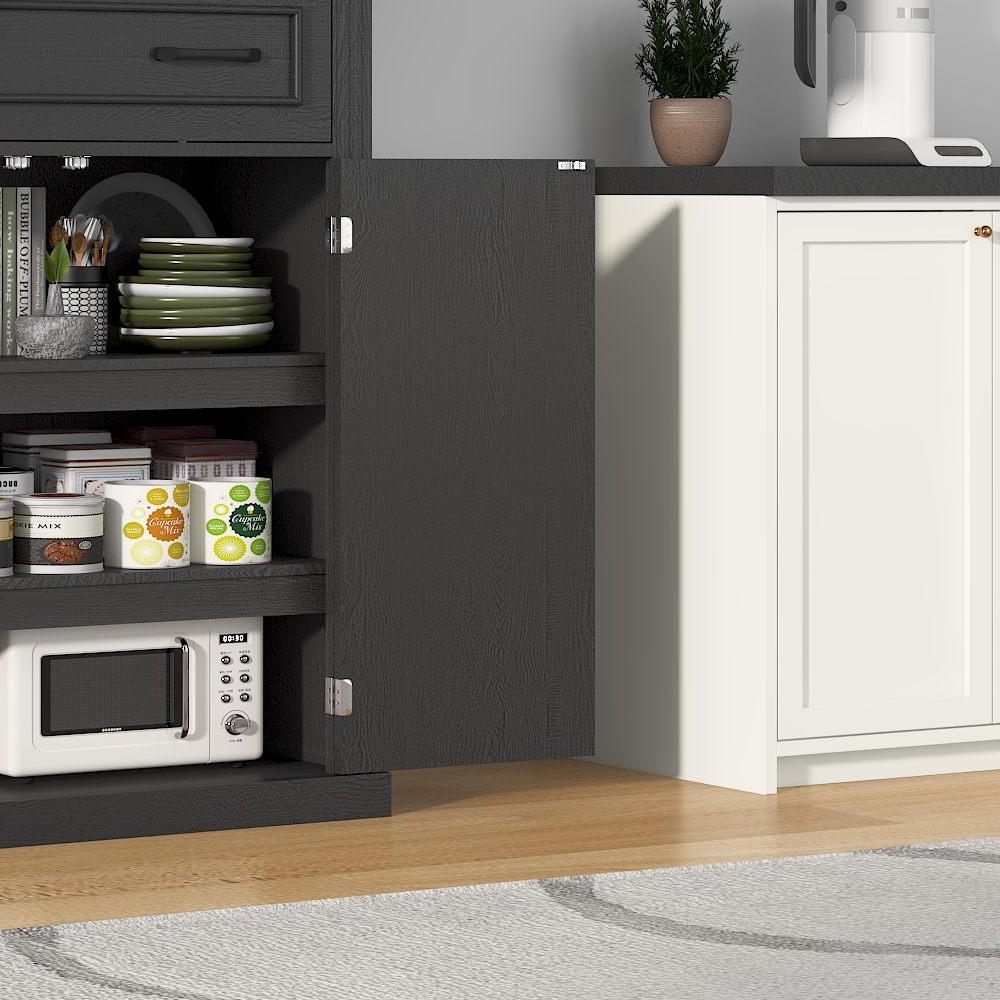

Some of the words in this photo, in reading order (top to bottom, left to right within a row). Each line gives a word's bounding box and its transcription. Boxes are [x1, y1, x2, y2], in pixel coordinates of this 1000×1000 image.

[19, 192, 29, 244] BUBBLE
[5, 249, 14, 303] baking
[6, 307, 14, 356] works
[148, 517, 183, 528] Cupcake
[231, 513, 265, 525] Cupcake
[159, 526, 181, 535] Mix
[242, 522, 263, 532] Mix
